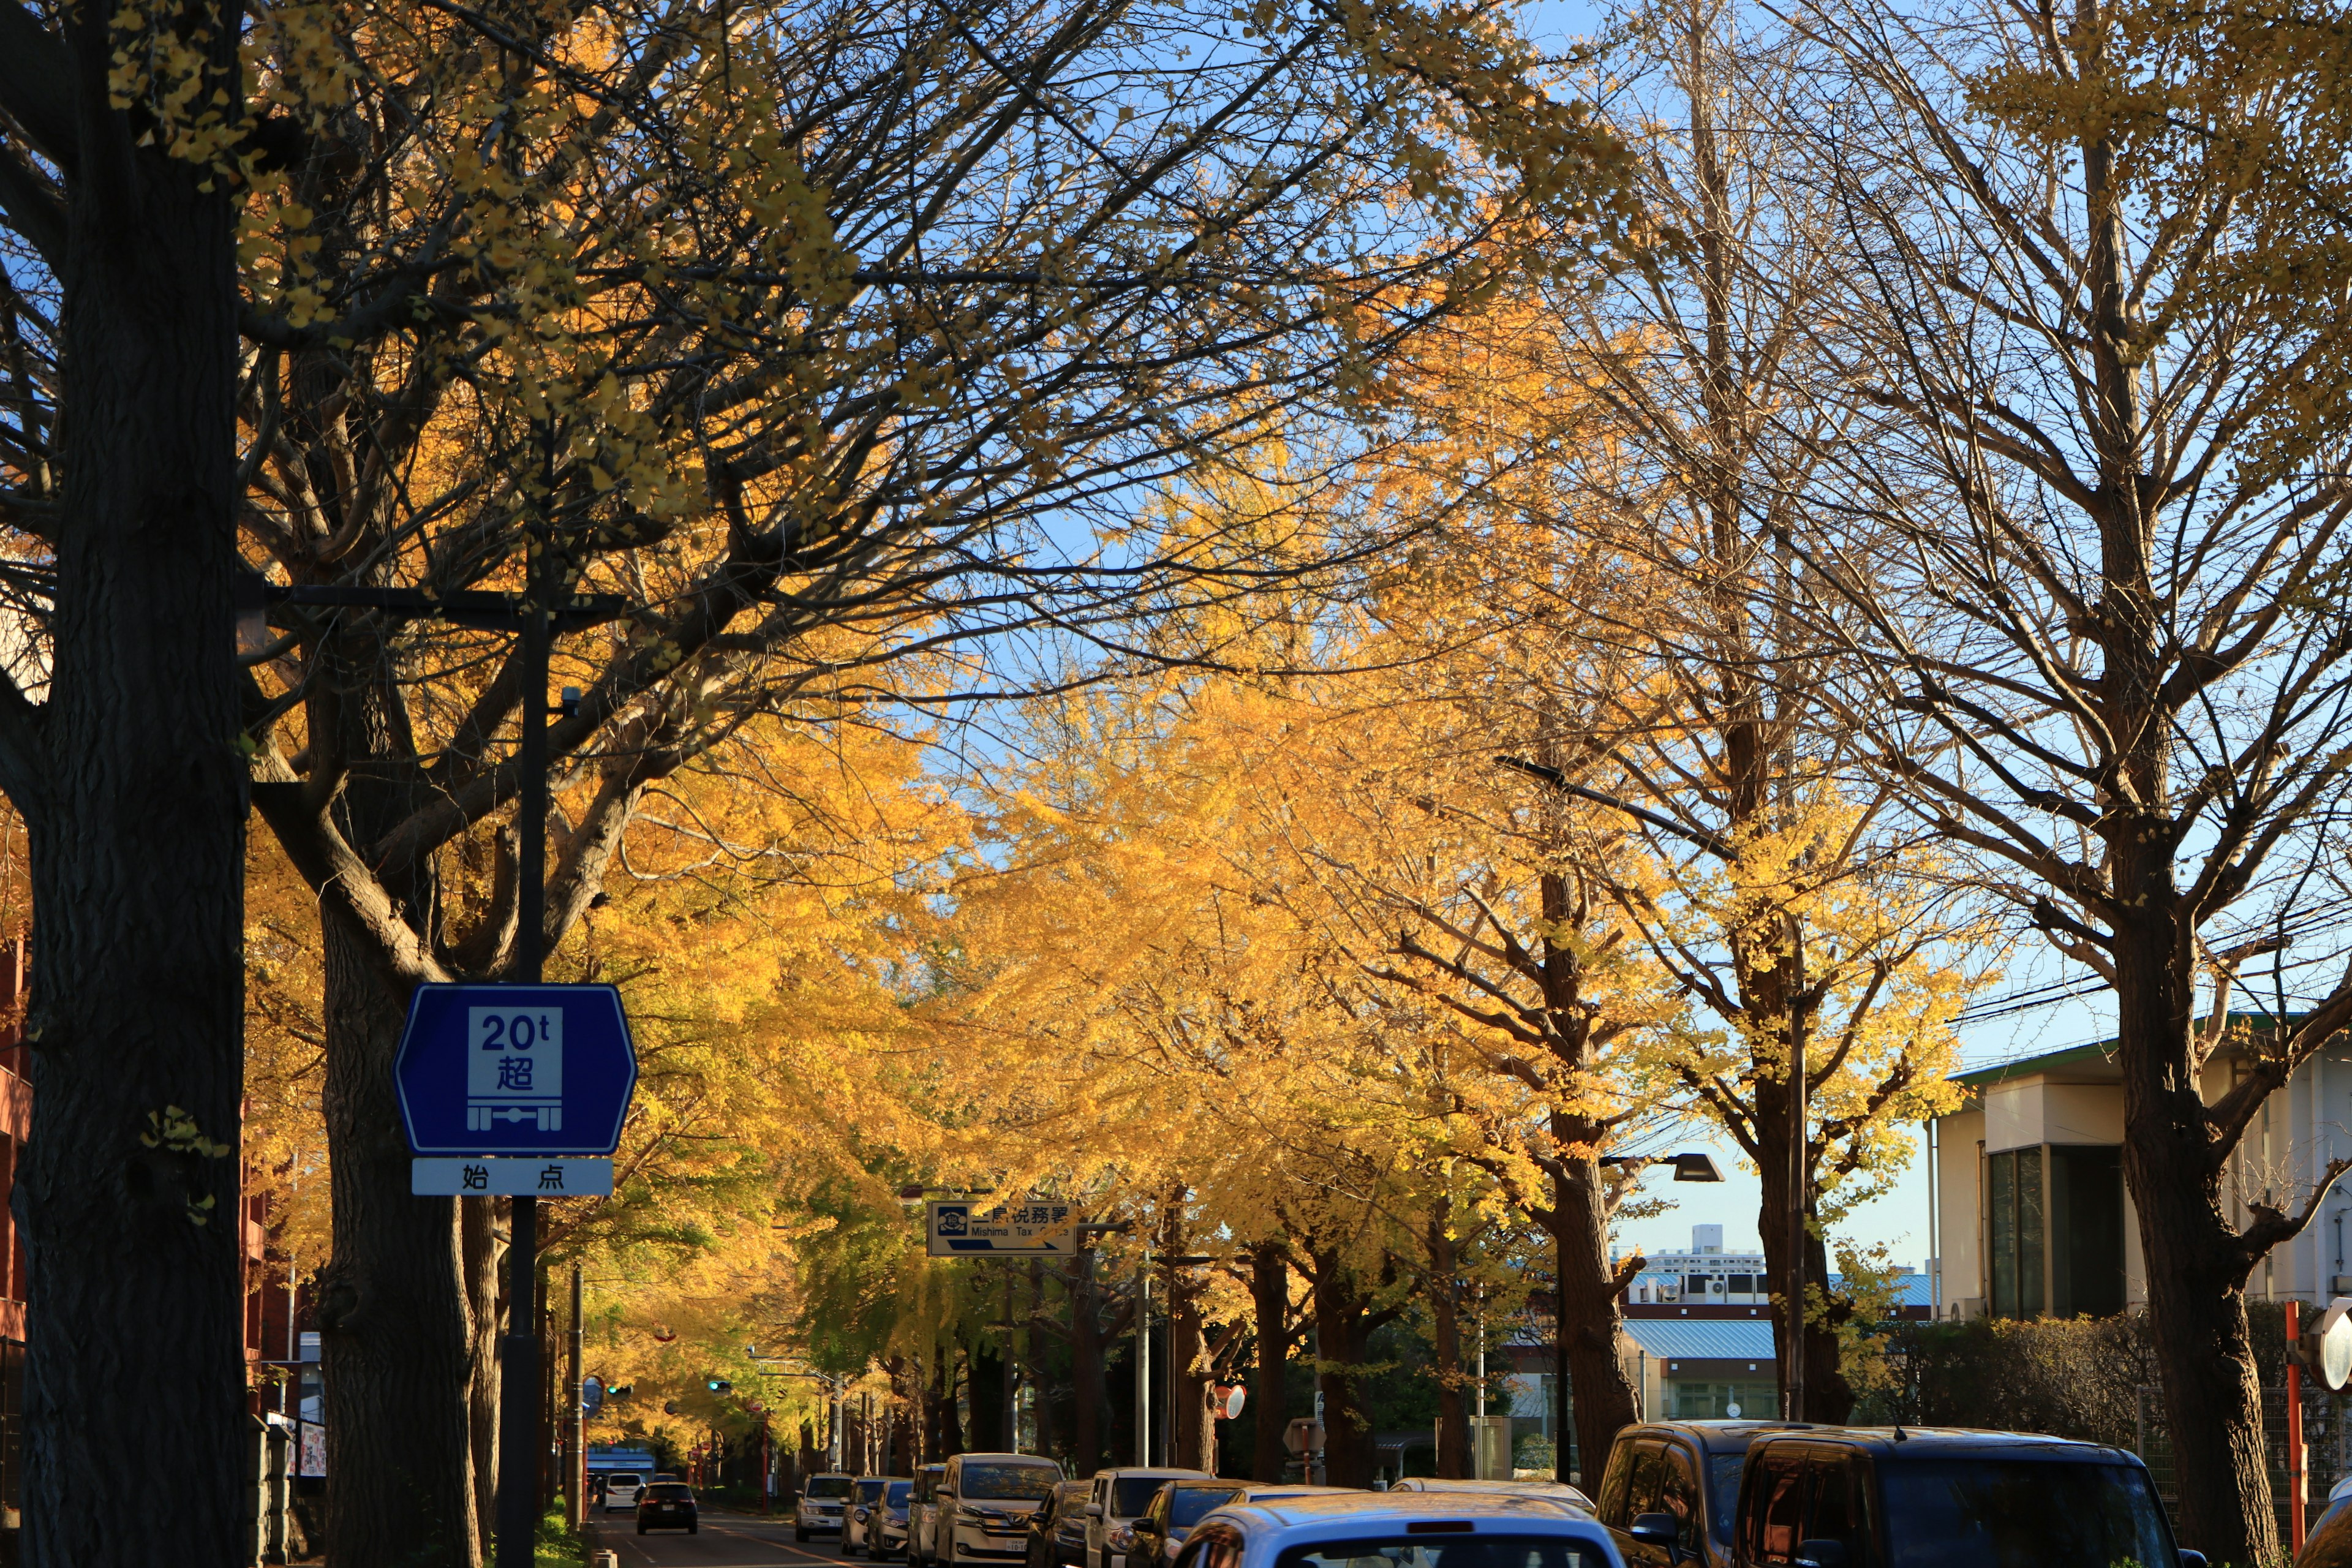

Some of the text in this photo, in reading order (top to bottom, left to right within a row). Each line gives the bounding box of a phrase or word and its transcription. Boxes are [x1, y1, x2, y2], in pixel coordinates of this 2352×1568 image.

[497, 1055, 533, 1091] 超
[971, 1227, 1009, 1237] Mishima
[1016, 1227, 1033, 1236] Tax
